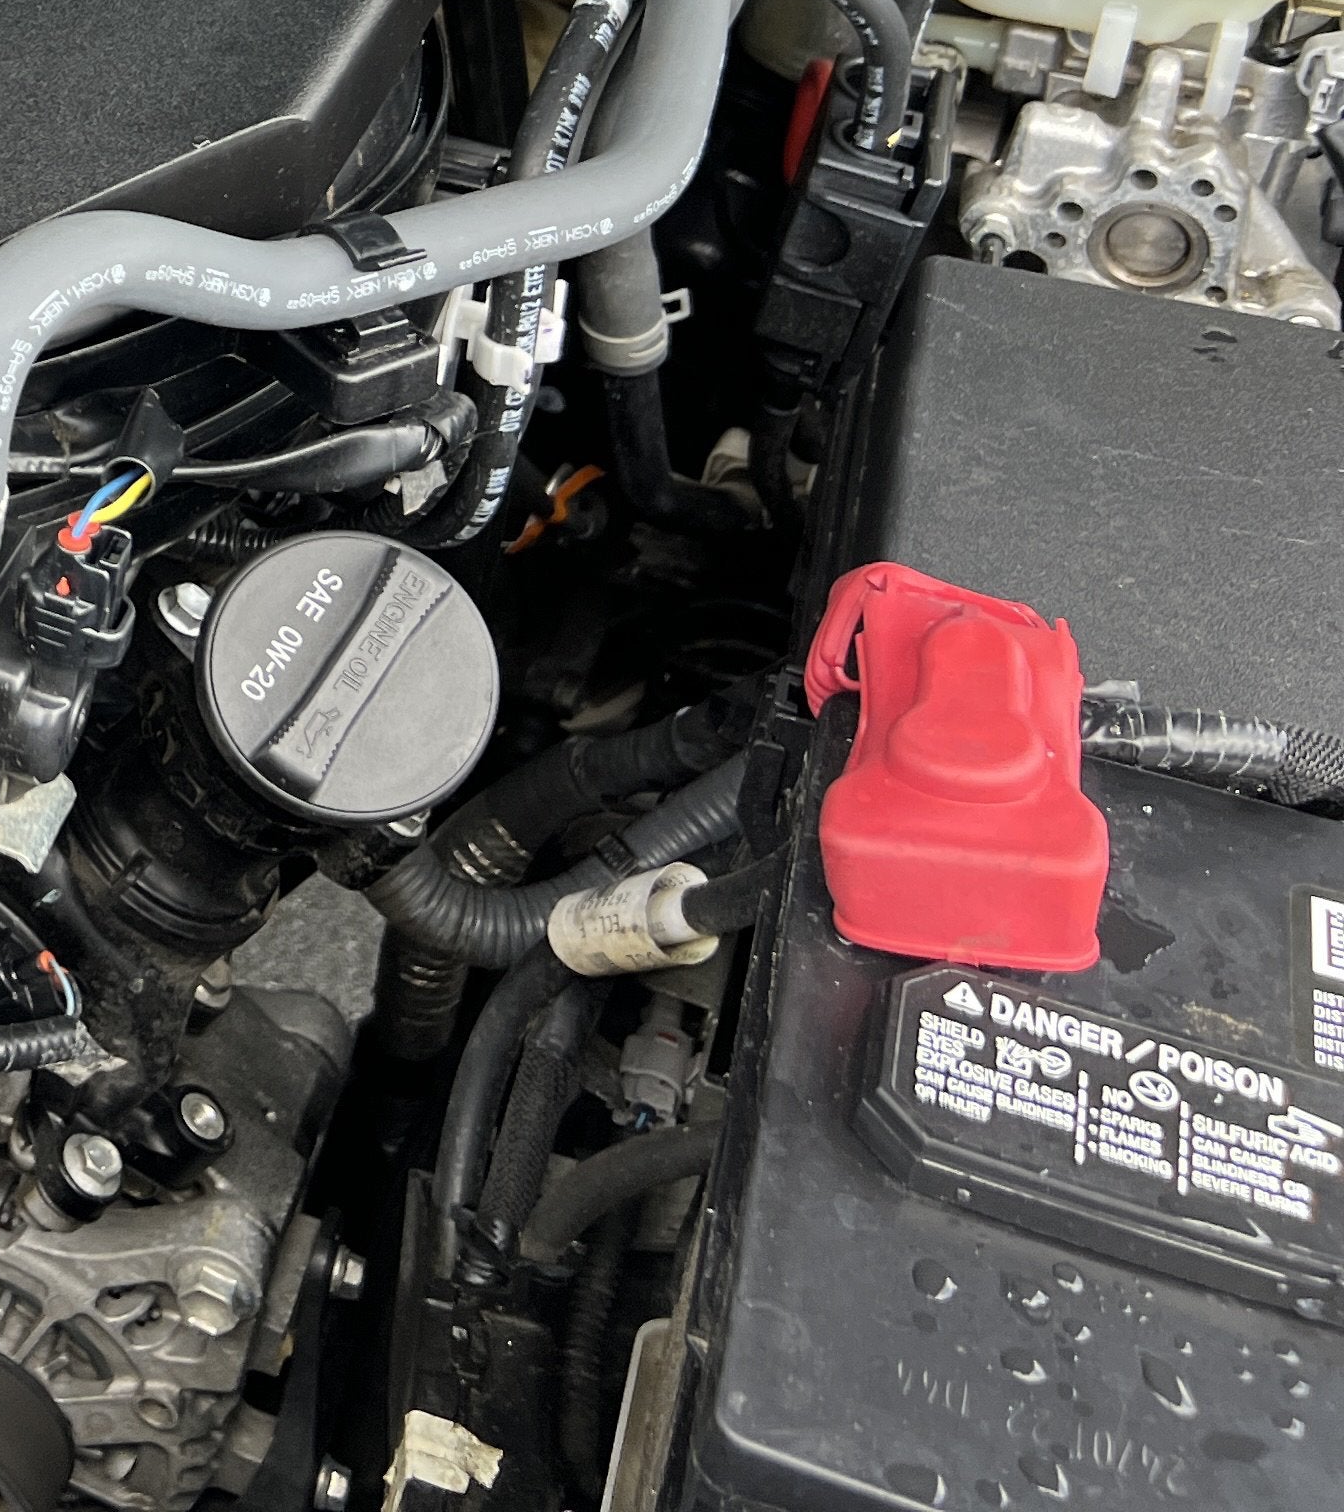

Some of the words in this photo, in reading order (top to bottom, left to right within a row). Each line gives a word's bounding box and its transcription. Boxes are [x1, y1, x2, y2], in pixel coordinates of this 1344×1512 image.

[295, 568, 343, 623] SAE
[358, 570, 429, 662] ENGINE
[333, 656, 368, 693] OIL
[918, 1028, 965, 1060] EYES
[920, 1010, 985, 1050] SHIELD
[990, 992, 1124, 1059] DANGER
[1158, 1044, 1286, 1106] POISON
[915, 1066, 945, 1090] CAN
[947, 1077, 994, 1105] CAUSE
[996, 1092, 1074, 1132] BLINDNESS
[916, 1045, 1013, 1094] EXPLOSIVE
[1014, 1078, 1076, 1113] GASES
[1102, 1086, 1134, 1112] NO
[938, 1091, 992, 1122] INJURY
[1100, 1107, 1162, 1139] SPARKS
[1098, 1141, 1173, 1180] SMOKING
[1099, 1124, 1163, 1158] FLAMES
[1192, 1113, 1289, 1160] SULFURIC
[1290, 1144, 1341, 1175] ACID
[1192, 1136, 1227, 1160] CAN
[1229, 1146, 1285, 1178] CAUSE
[1192, 1152, 1281, 1194] BLINDNESS
[1191, 1171, 1253, 1202] SEVERE
[1253, 1187, 1312, 1220] BURNS
